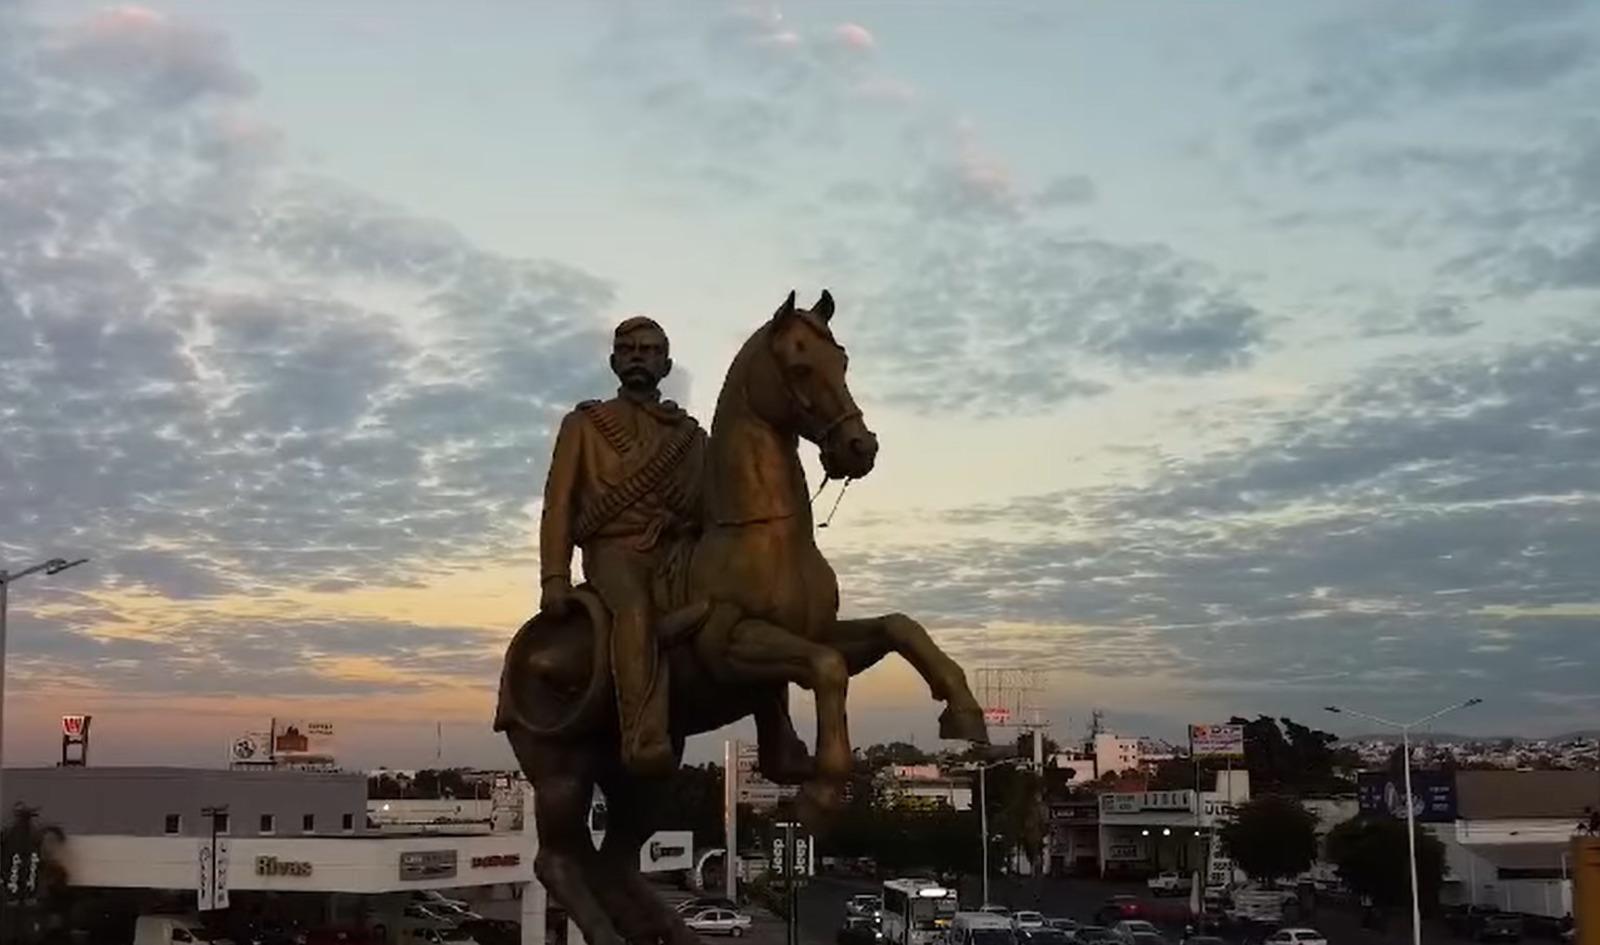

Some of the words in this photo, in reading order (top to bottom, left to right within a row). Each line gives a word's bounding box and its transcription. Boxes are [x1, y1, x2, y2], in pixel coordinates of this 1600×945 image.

[255, 855, 313, 877] Rivas
[771, 838, 785, 874] Jeep
[794, 838, 808, 875] Jeep
